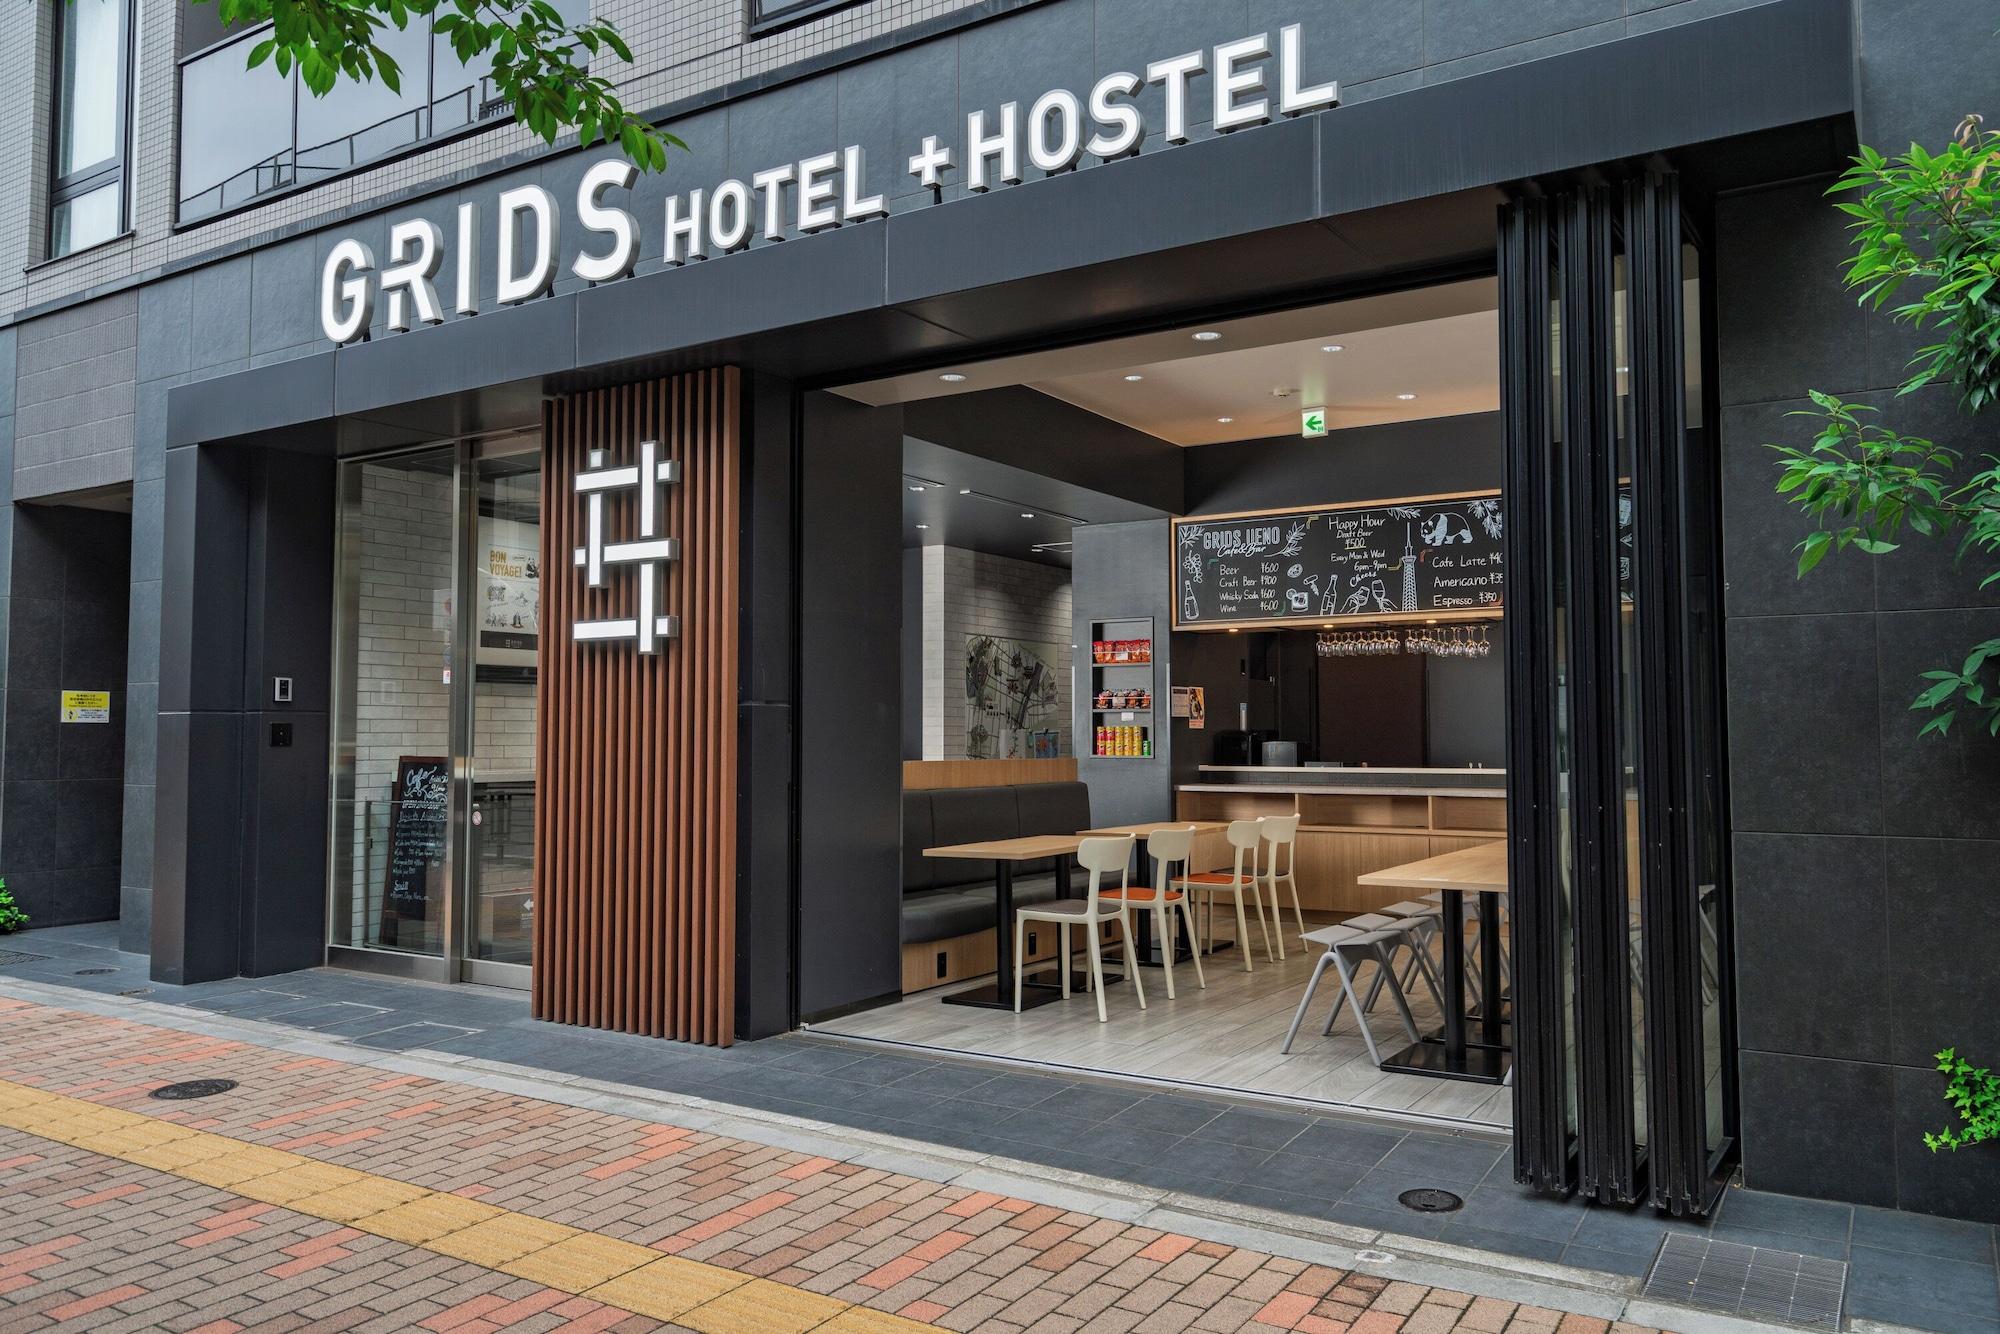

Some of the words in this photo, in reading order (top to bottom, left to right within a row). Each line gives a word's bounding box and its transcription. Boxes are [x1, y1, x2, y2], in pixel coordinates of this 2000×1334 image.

[321, 159, 640, 344] GRIDS
[663, 145, 889, 264] HOTEL
[967, 23, 1341, 193] HOSTEL
[1328, 516, 1358, 530] Happy
[1360, 514, 1386, 528] Hour
[1203, 529, 1241, 550] GRIDS
[1246, 526, 1280, 546] UENO
[1357, 528, 1373, 537] Beer
[490, 550, 506, 563] BON
[1330, 553, 1348, 564] Every
[1348, 552, 1362, 560] Mon
[1370, 550, 1386, 558] Wed
[1432, 556, 1454, 568] Cafe
[1460, 555, 1487, 567] Latte
[490, 563, 522, 578] VOYAGE!
[1220, 564, 1239, 576] Beer
[1220, 578, 1239, 588] Craft
[1243, 576, 1257, 586] Beer
[1433, 576, 1488, 588] Americano
[1220, 592, 1242, 603] Whisky
[1244, 590, 1260, 600] Soda
[1433, 594, 1473, 608] Espresso
[1220, 604, 1237, 614] Wine
